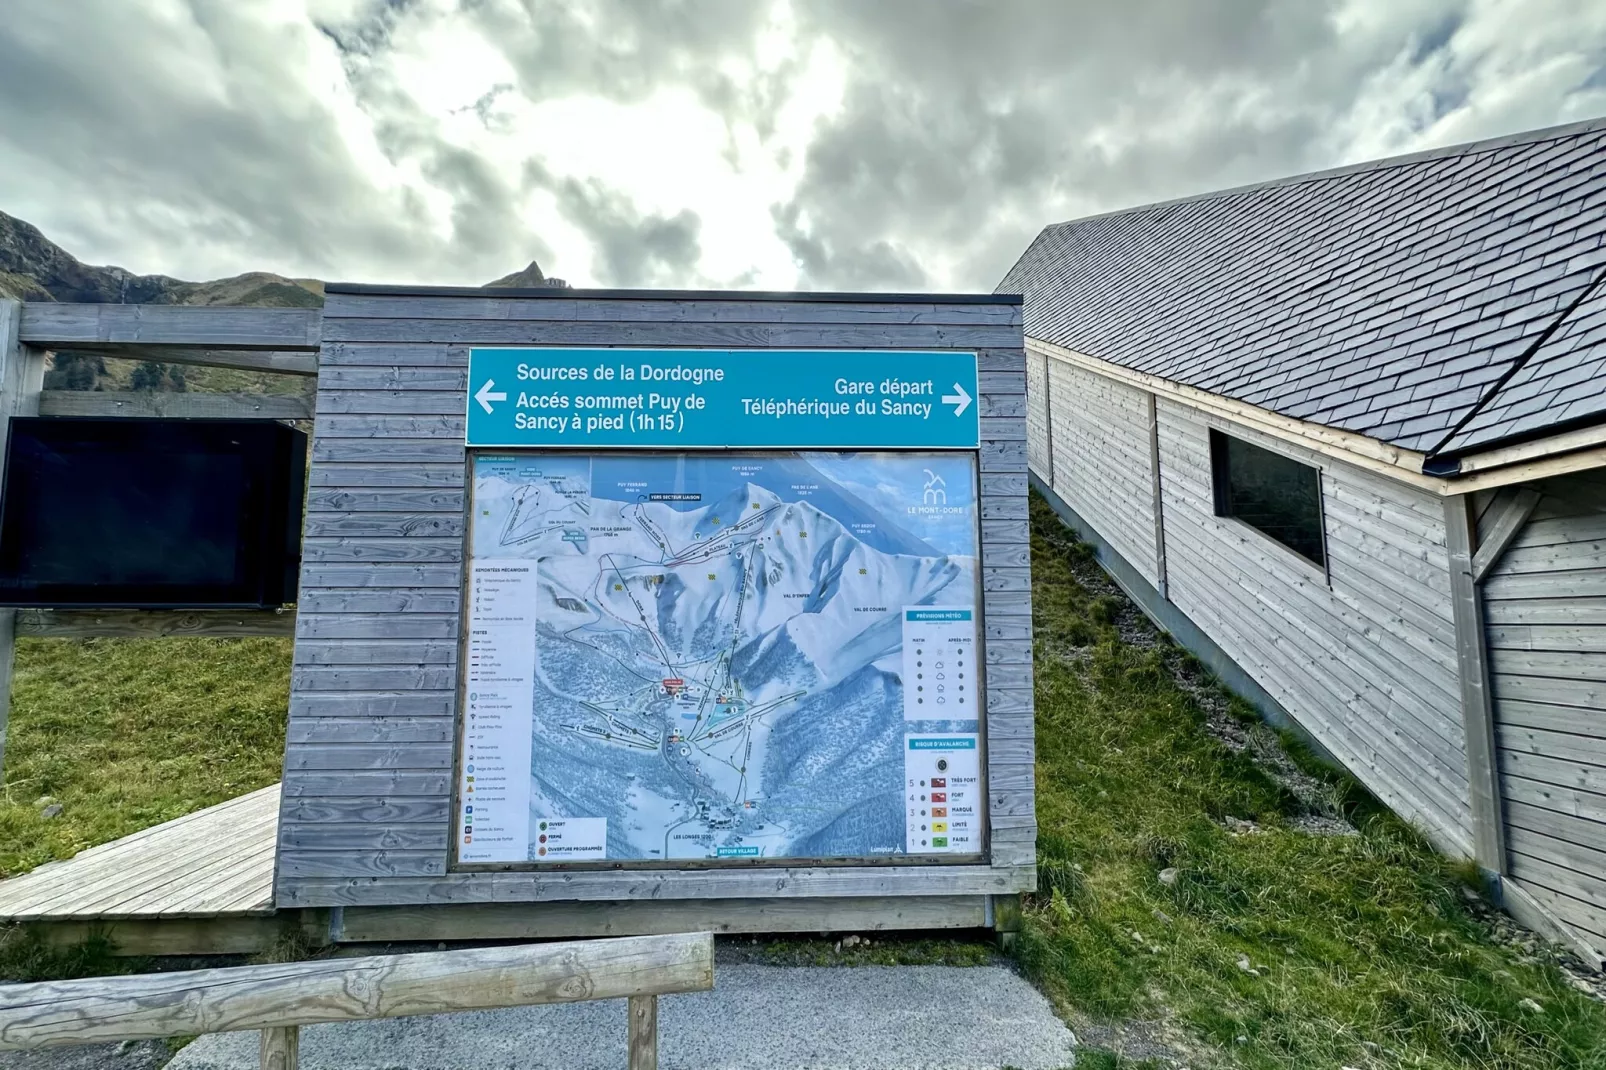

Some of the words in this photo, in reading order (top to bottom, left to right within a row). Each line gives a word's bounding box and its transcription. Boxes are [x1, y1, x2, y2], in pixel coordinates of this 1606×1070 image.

[516, 364, 588, 380] Sources
[593, 364, 614, 380] de
[621, 364, 635, 380] la
[640, 364, 724, 384] Dordogne
[835, 378, 874, 396] Gare
[880, 378, 933, 398] départ
[516, 391, 569, 408] Accés
[575, 393, 643, 409] sommet
[649, 393, 680, 413] Puy
[685, 394, 705, 409] de
[741, 398, 850, 419] Téléphérique
[855, 400, 876, 415] du
[881, 399, 932, 419] Sancy
[515, 413, 567, 433] Sancy
[572, 413, 581, 429] à
[587, 414, 623, 433] pied
